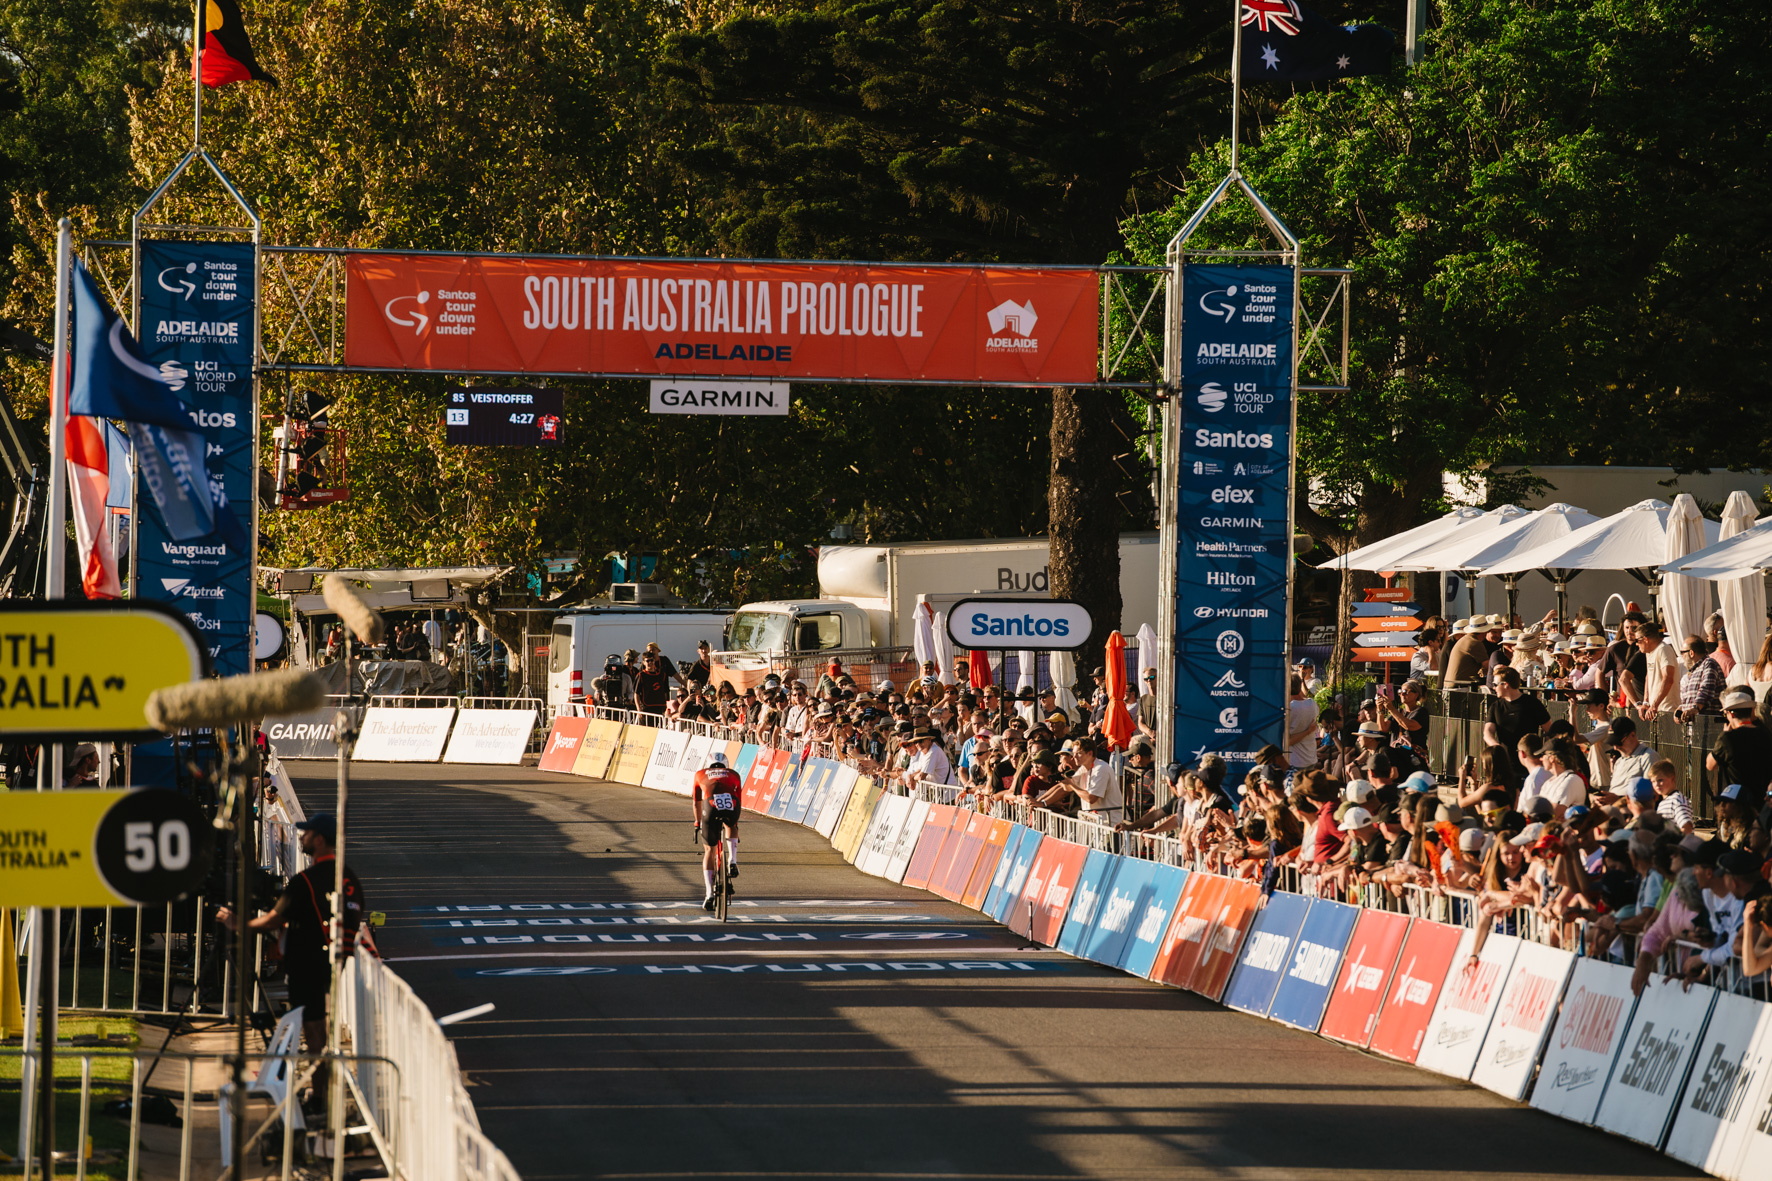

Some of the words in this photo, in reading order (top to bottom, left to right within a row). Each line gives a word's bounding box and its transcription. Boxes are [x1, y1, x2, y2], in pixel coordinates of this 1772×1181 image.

[204, 262, 237, 270] Santos
[211, 272, 237, 280] tour
[206, 281, 236, 290] down
[1244, 284, 1276, 293] Santos
[203, 291, 237, 300] under
[438, 289, 476, 300] Santos
[1251, 295, 1276, 303] tour
[446, 302, 476, 312] tour
[523, 275, 614, 331] SOUTH
[623, 278, 772, 335] AUSTRALIA
[782, 281, 924, 337] PROLOGUE
[1245, 304, 1275, 312] down
[439, 312, 475, 323] down
[1242, 314, 1275, 322] under
[156, 321, 238, 336] ADELAIDE
[436, 324, 475, 335] under
[986, 338, 1038, 348] ADELAIDE
[655, 343, 791, 362] ADELAIDE
[1197, 343, 1276, 358] ADELAIDE
[195, 361, 217, 370] UCI
[195, 372, 236, 382] WORLD
[195, 382, 225, 392] TOUR
[1234, 383, 1256, 392] UCI
[453, 394, 464, 402] 85
[471, 394, 533, 404] VEISTROFFER
[661, 390, 773, 408] GARMIN
[1234, 394, 1274, 403] WORLD
[1234, 404, 1263, 413] TOUR
[452, 413, 464, 422] 13
[509, 413, 534, 423] 4:27
[1196, 429, 1273, 448] Santos
[1212, 485, 1254, 503] efex
[162, 542, 226, 557] Vanguard
[1196, 542, 1227, 551] Health
[1229, 542, 1267, 552] Partners
[1207, 572, 1256, 585] Hilton
[183, 586, 224, 599] Ziptrak
[1217, 609, 1268, 618] HYUNDAI
[972, 613, 1069, 636] Santos
[371, 722, 389, 734] The
[389, 722, 437, 734] Advertiser
[462, 723, 477, 735] The
[477, 723, 520, 736] Advertiser
[716, 798, 732, 809] 85
[125, 821, 190, 872] 50
[436, 901, 758, 911] HYUNDAI
[450, 915, 788, 927] HYUNDAI
[461, 933, 817, 944] HYUNDAI
[1243, 931, 1290, 972] SHIMANO
[644, 961, 1035, 974] HYUNDAI
[1289, 940, 1340, 986] SHIMANO
[1572, 992, 1624, 1055] YAMAHA
[1620, 1021, 1690, 1096] Santini
[1691, 1043, 1762, 1122] Santini
